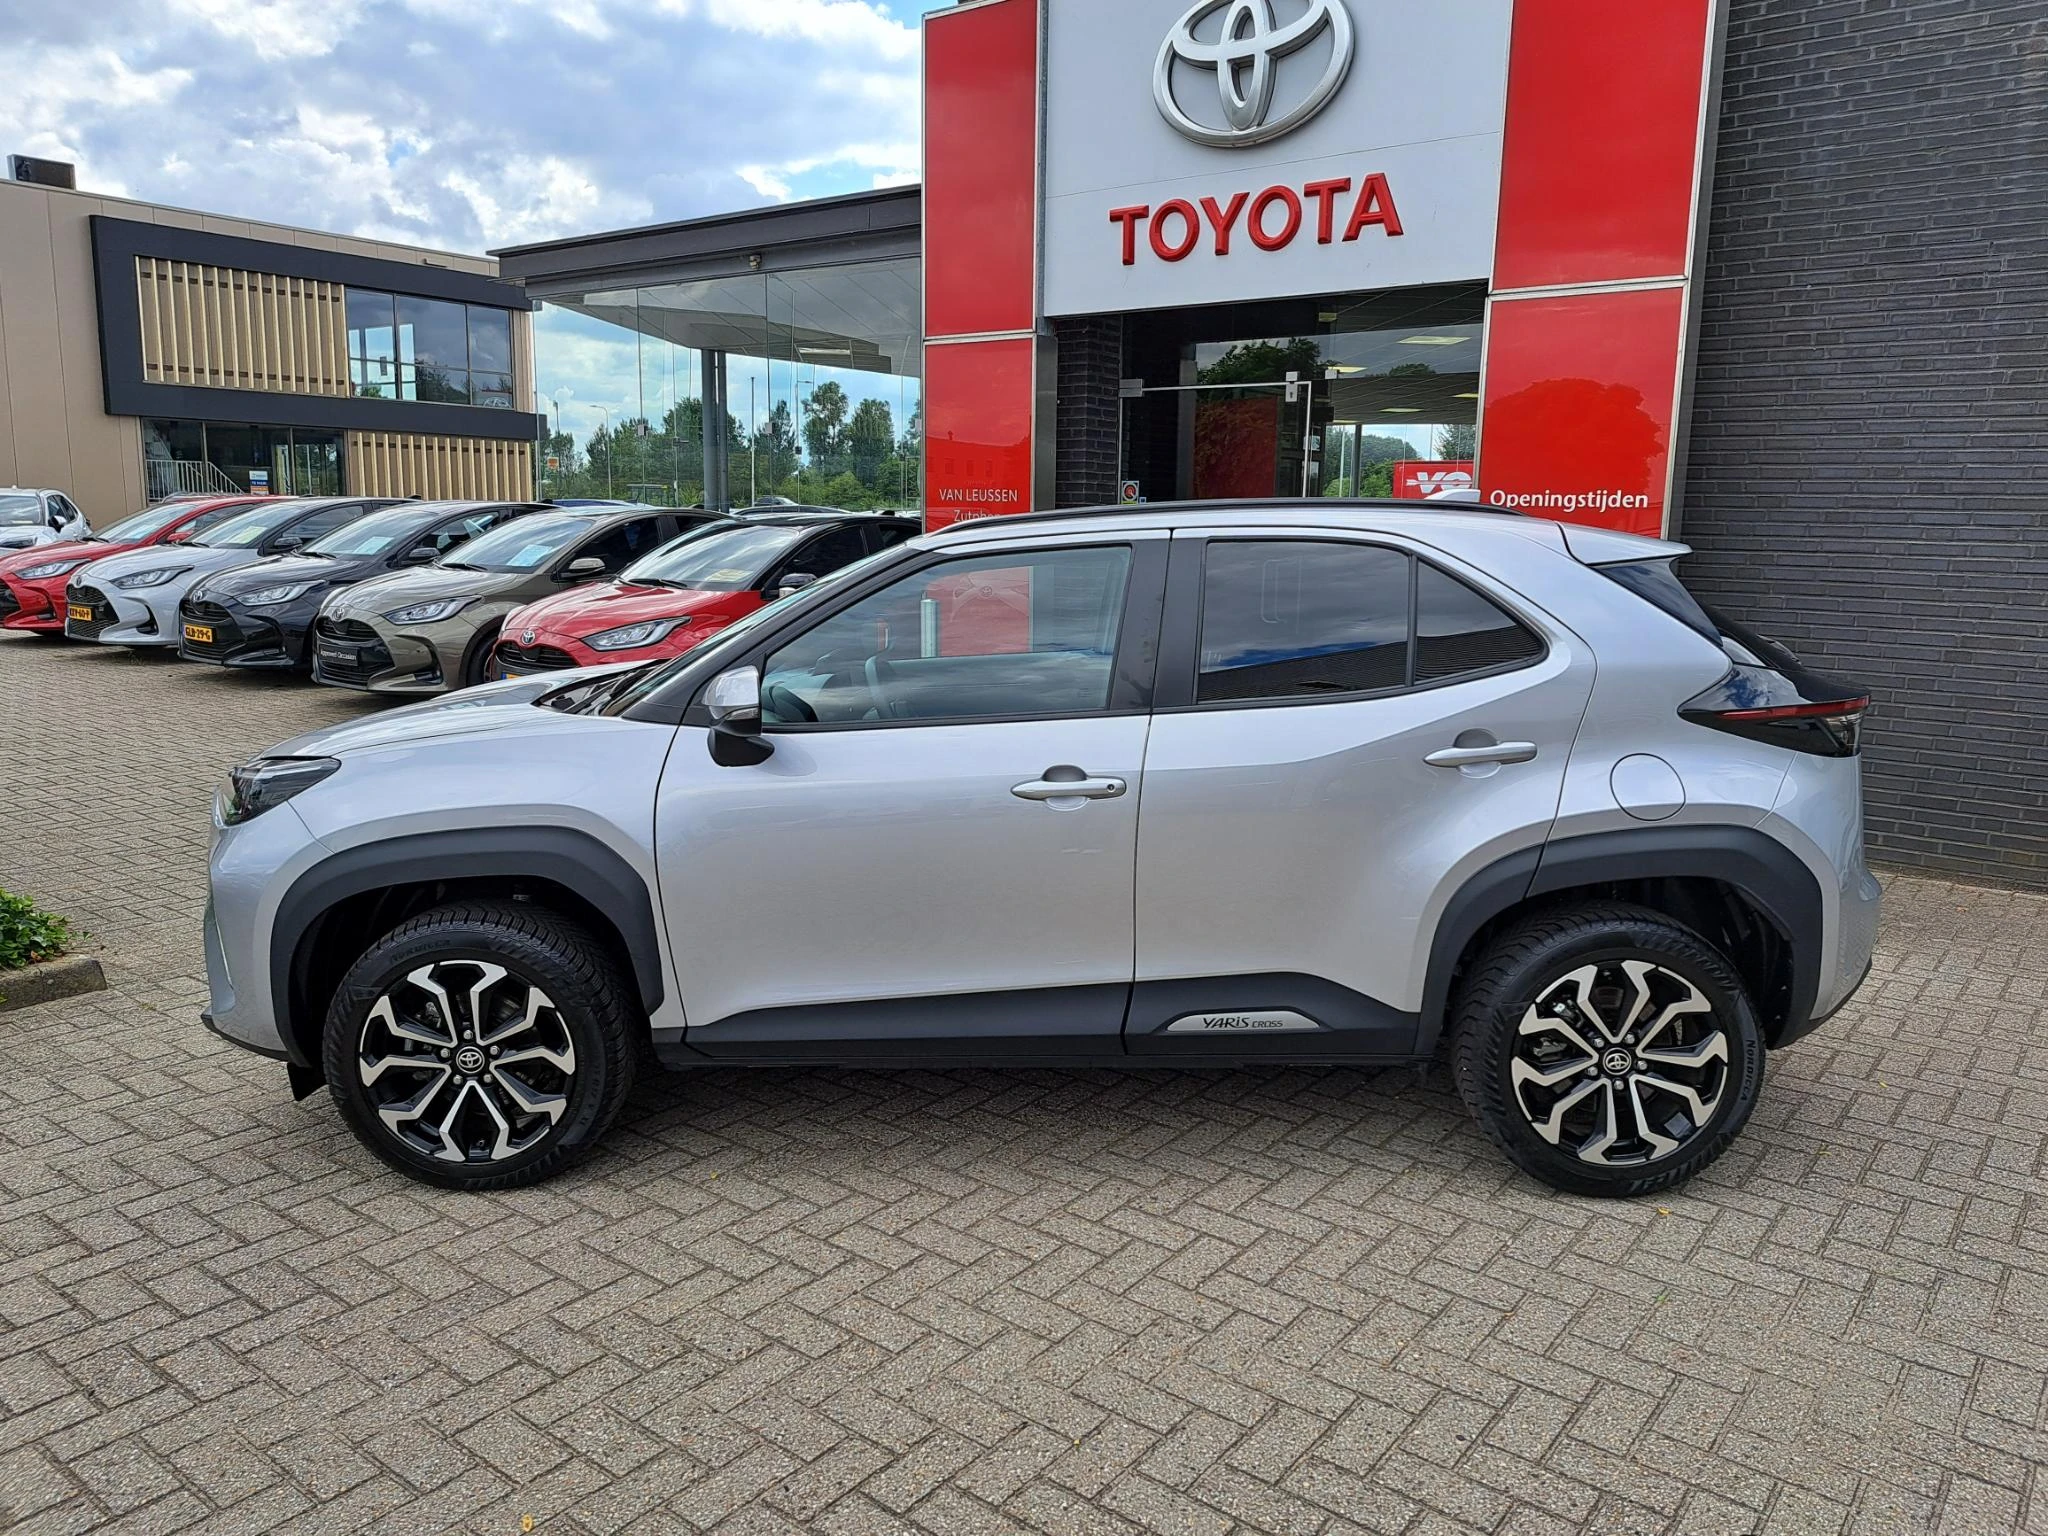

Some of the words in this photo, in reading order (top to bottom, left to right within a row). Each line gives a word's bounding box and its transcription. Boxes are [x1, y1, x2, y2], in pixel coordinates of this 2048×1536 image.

[1109, 172, 1404, 266] TOYOTA
[939, 488, 963, 501] VAN
[966, 489, 1018, 502] LEUSSEN
[1489, 489, 1649, 513] Openingstijden
[1252, 1020, 1283, 1028] CROSS
